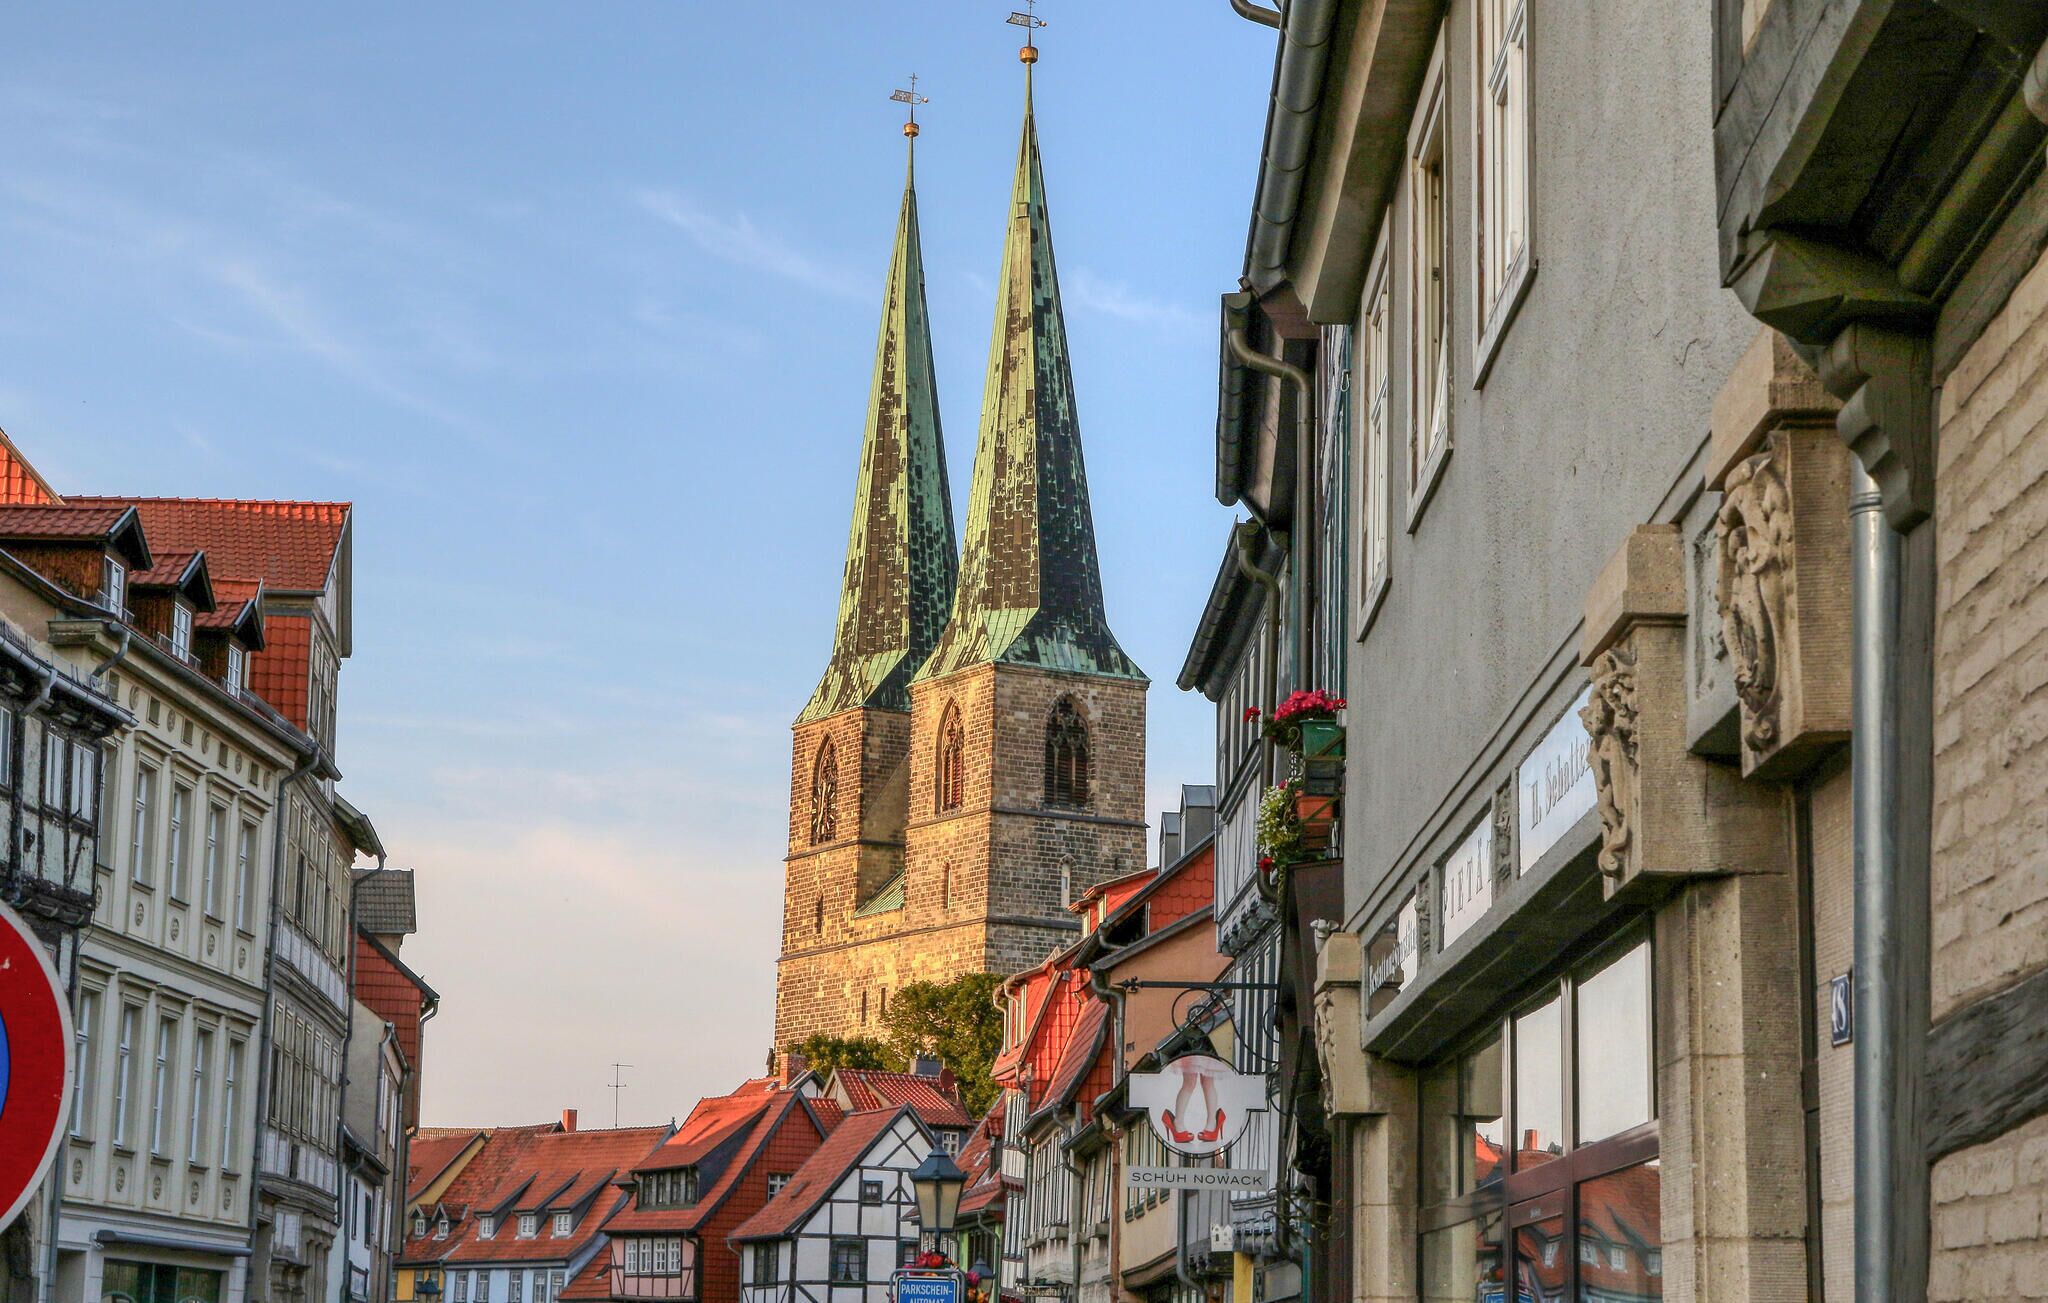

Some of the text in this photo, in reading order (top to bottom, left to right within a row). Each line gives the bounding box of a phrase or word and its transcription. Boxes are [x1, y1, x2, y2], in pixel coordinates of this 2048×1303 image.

[1131, 1171, 1263, 1187] SCHUH NOWACK
[901, 1283, 953, 1296] PARKSCHEIN-
